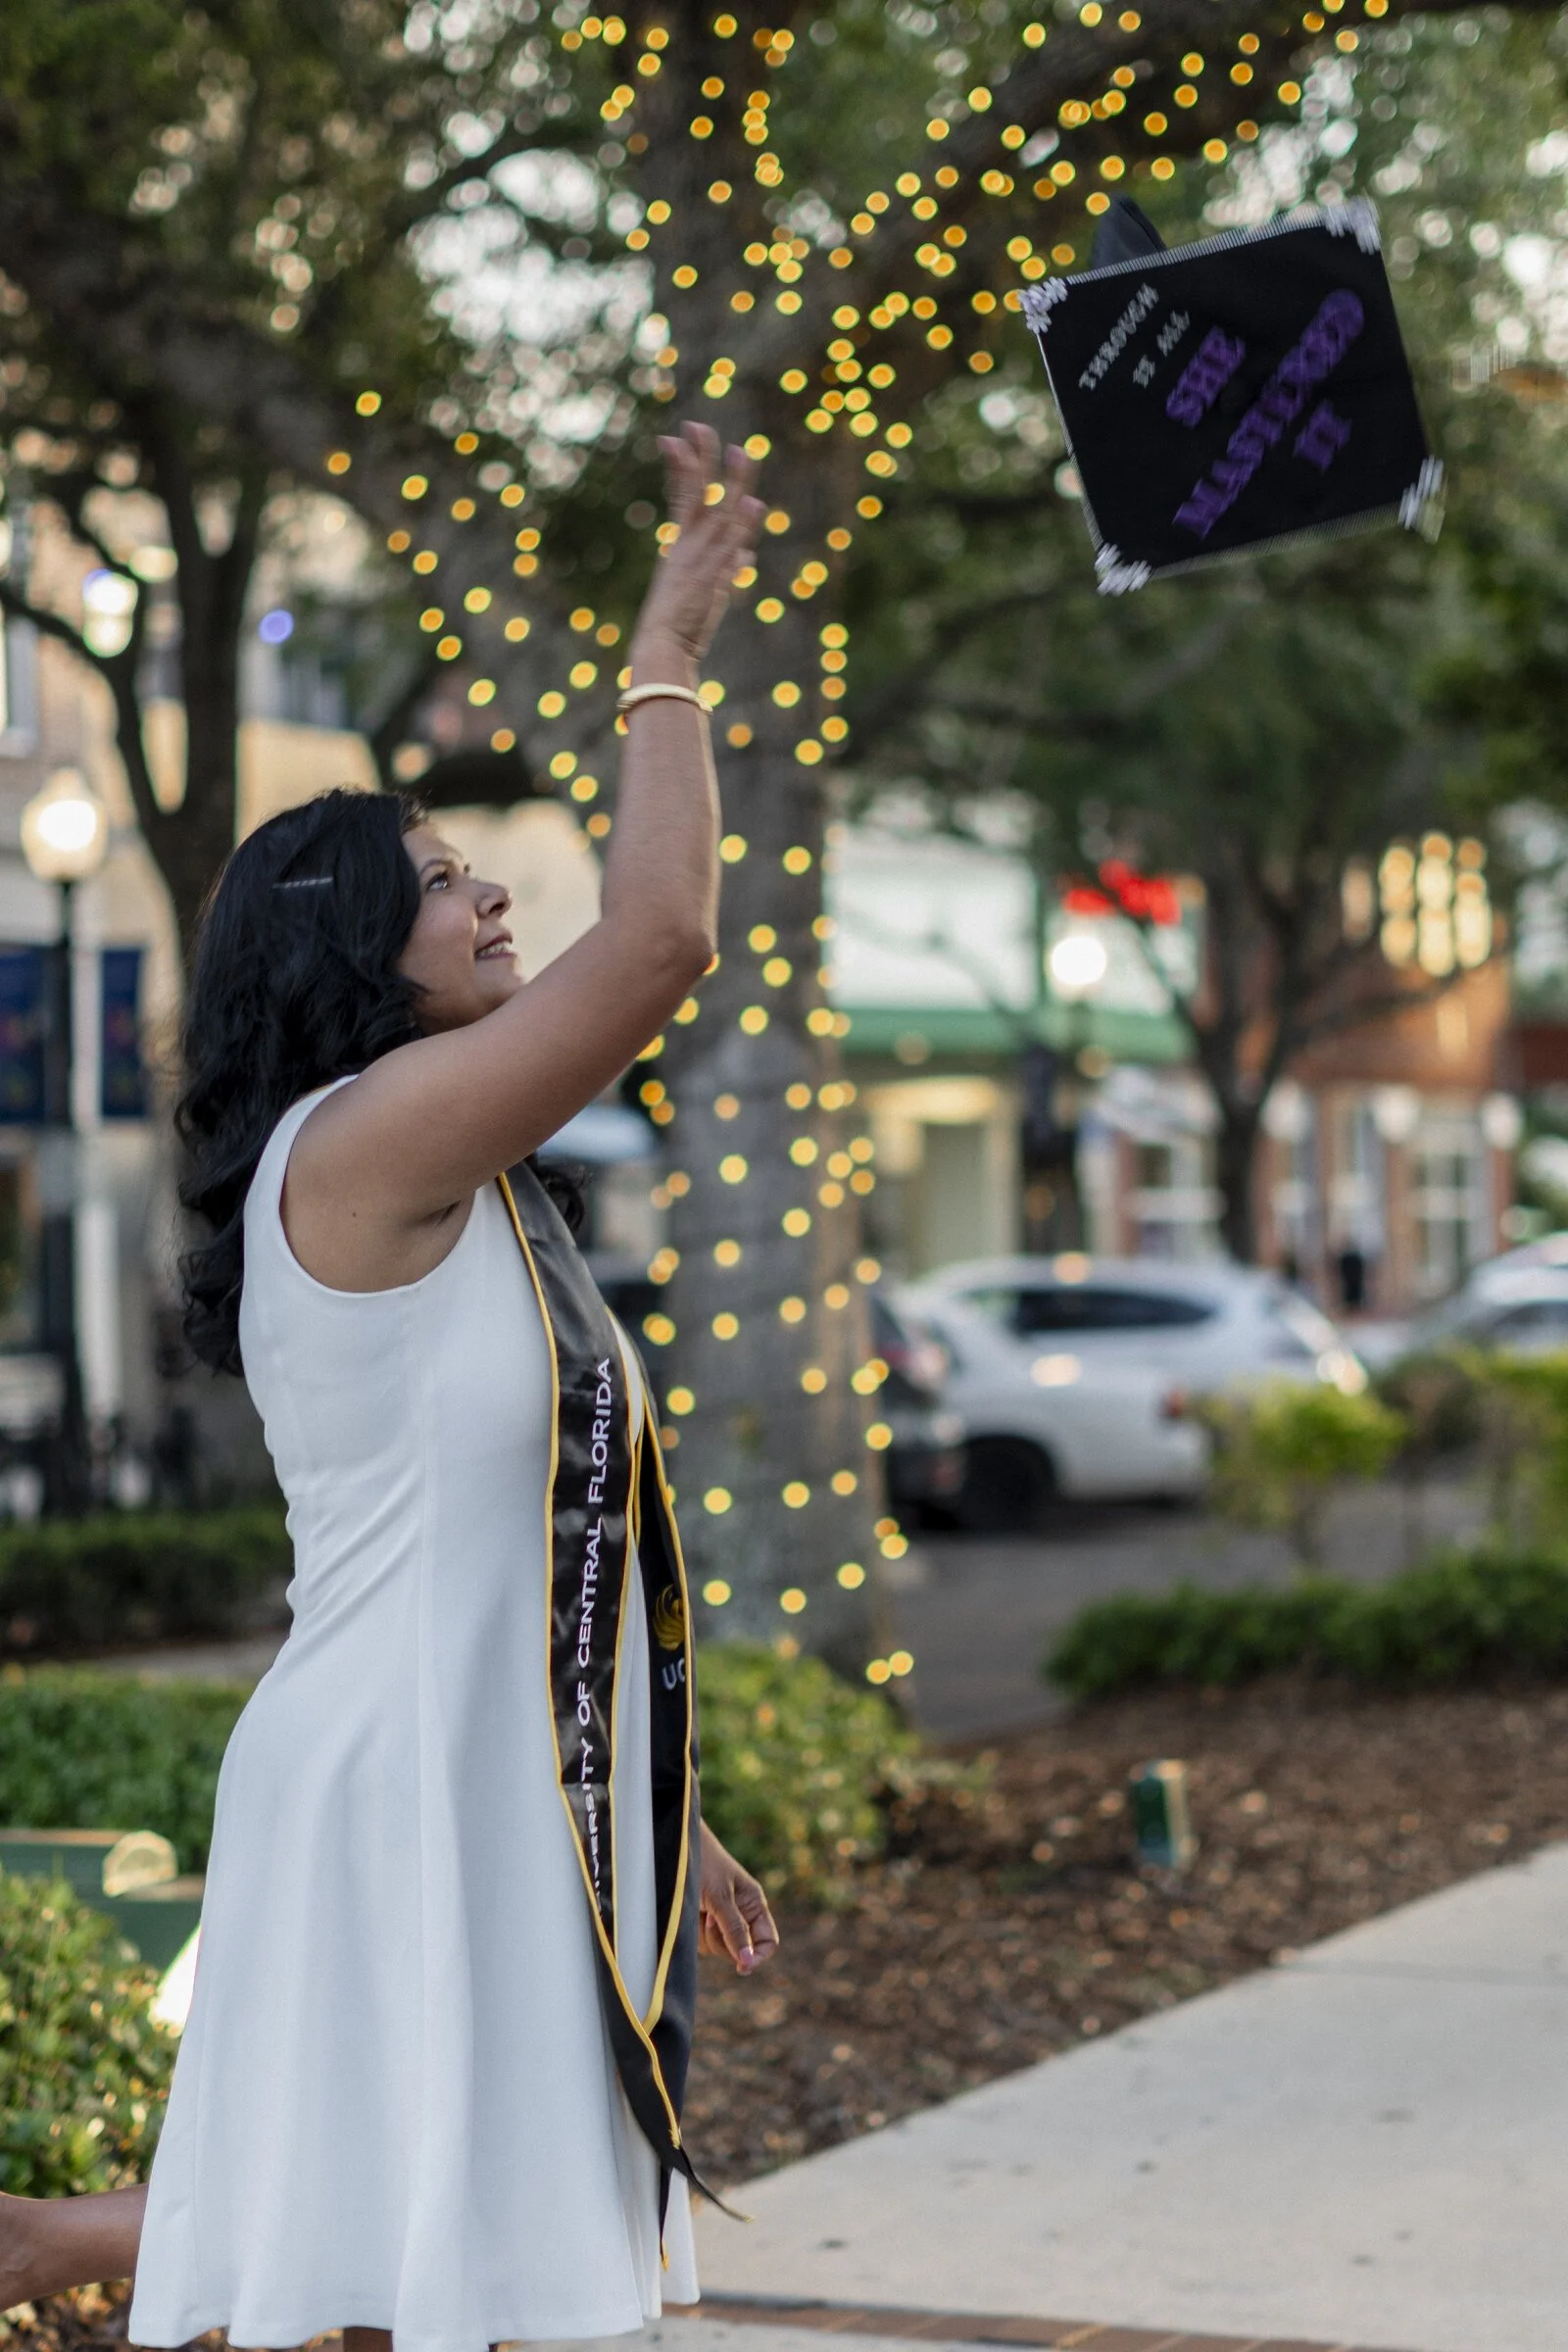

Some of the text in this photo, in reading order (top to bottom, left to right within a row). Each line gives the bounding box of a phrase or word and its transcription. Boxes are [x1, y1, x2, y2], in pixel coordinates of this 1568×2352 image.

[1165, 325, 1246, 426] SHE
[588, 1358, 612, 1504] FLORIDA
[578, 1517, 602, 1668] CENTRAL
[577, 1681, 591, 1727] OF
